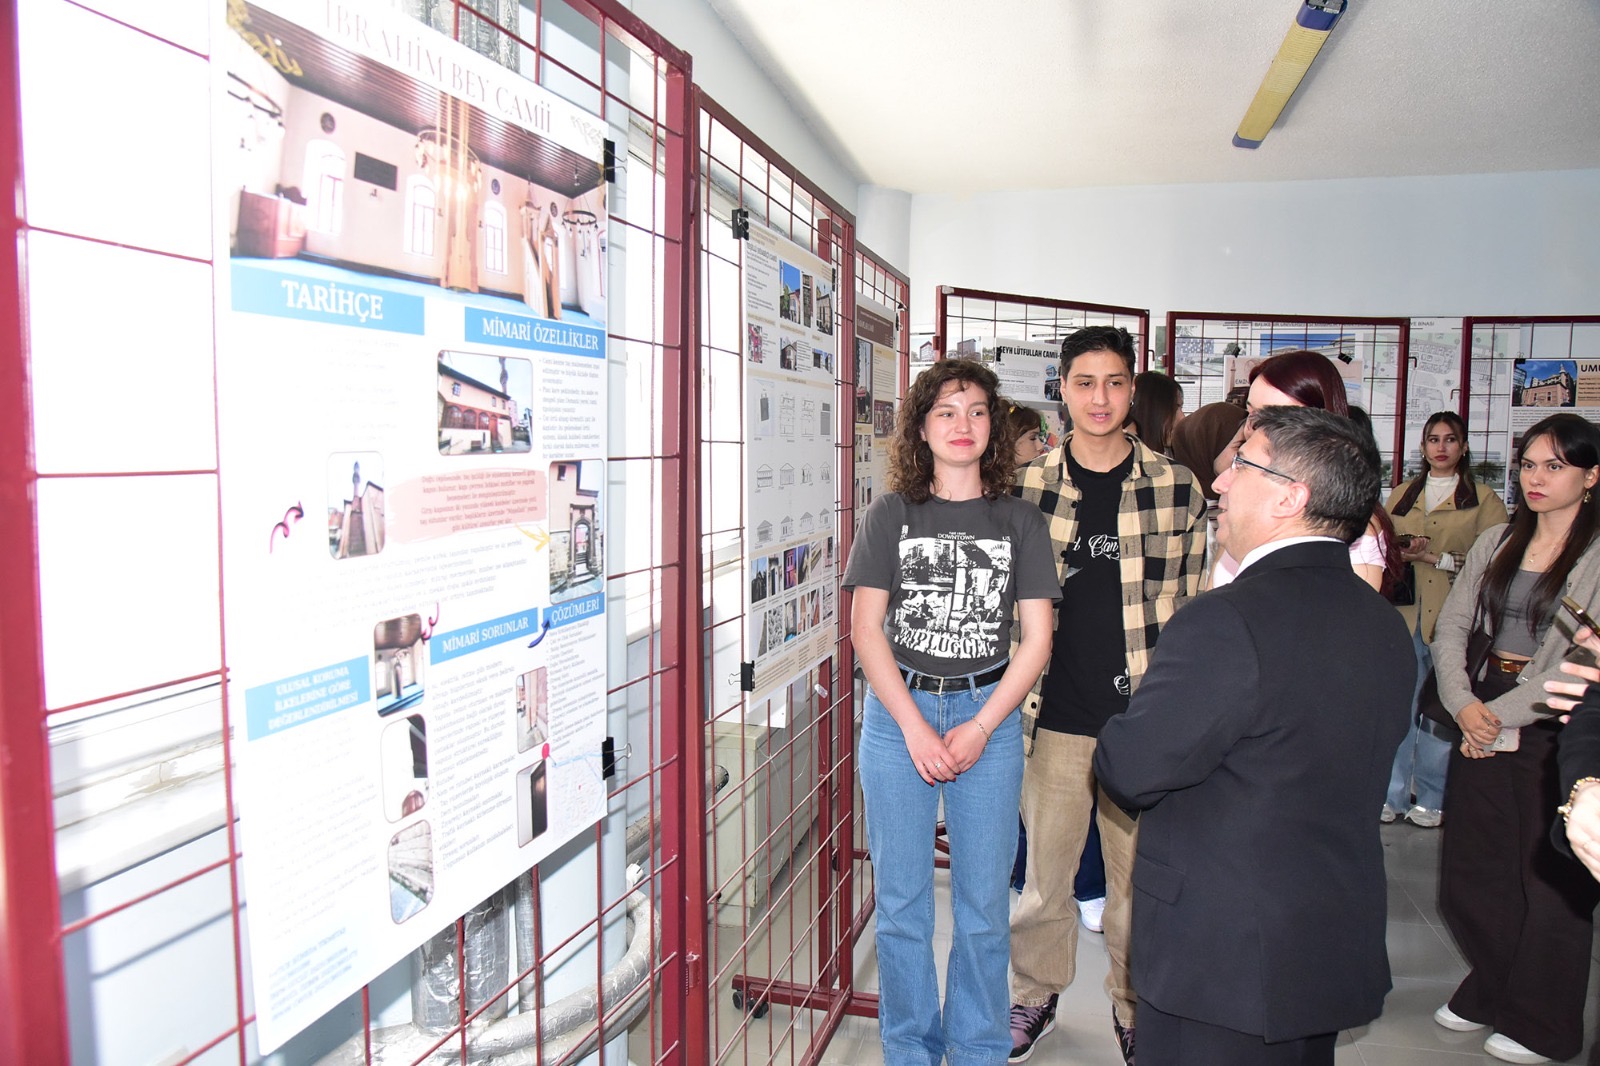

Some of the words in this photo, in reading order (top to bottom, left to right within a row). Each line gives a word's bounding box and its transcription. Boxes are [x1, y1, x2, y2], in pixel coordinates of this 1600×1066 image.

[451, 62, 490, 103] BEY
[281, 279, 384, 323] TARİHÇE
[482, 316, 531, 342] MİMARİ
[533, 321, 599, 351] ÖZELLİKLER
[1013, 345, 1042, 358] LÜTFULLAH
[937, 533, 975, 541] DOWNTOWN
[551, 598, 600, 625] ÇÖZÜMLERİ
[442, 629, 480, 654] MİMARİ
[481, 616, 529, 643] SORUNLAR
